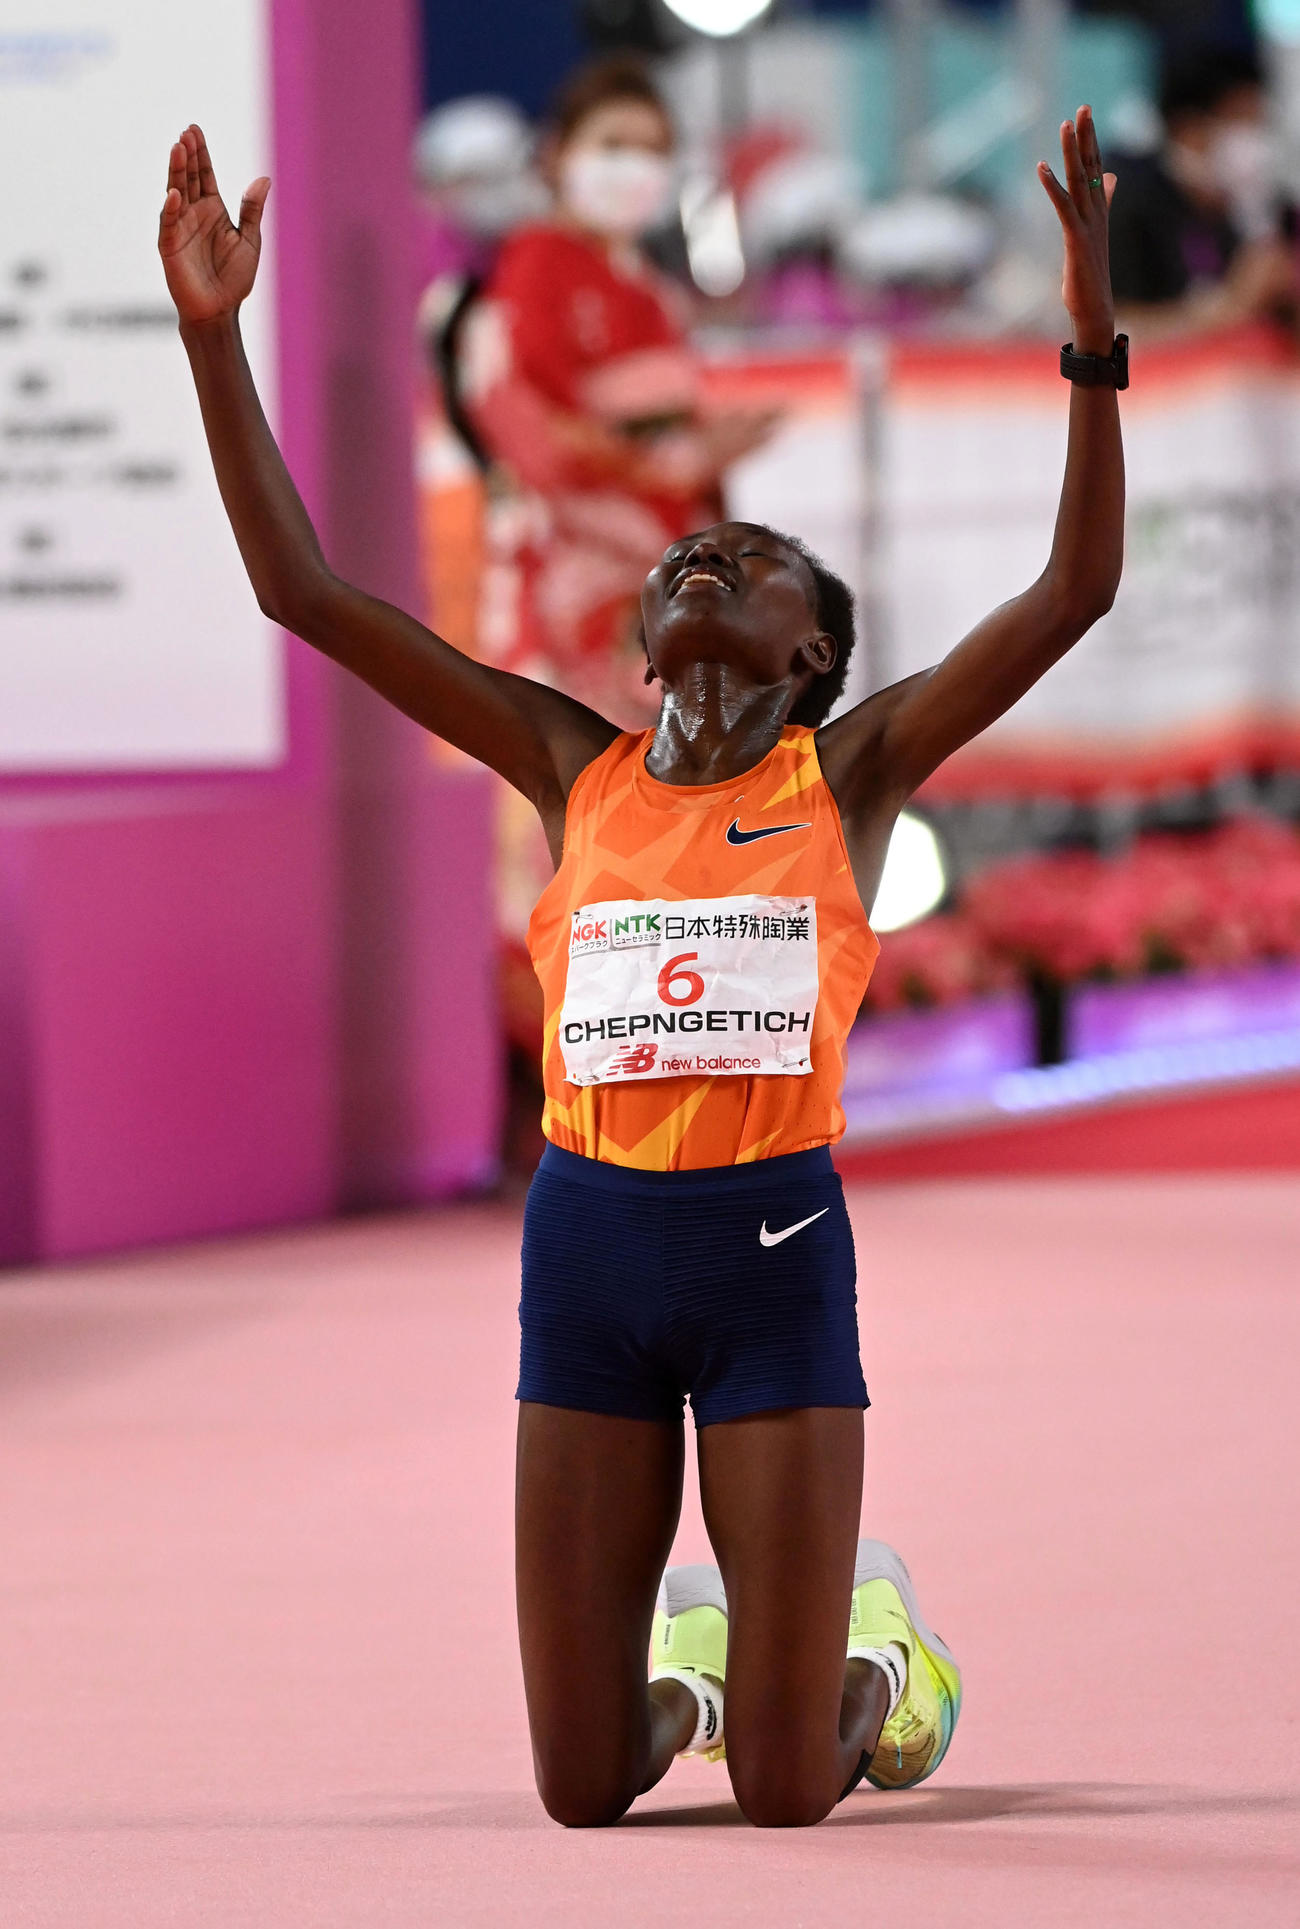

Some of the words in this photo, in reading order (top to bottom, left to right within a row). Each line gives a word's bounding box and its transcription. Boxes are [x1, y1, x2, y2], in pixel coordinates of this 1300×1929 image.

[572, 920, 607, 945] NGK
[615, 914, 661, 935] NTK
[665, 915, 810, 941] 日本特殊陶業
[657, 952, 705, 1007] 6
[564, 1010, 810, 1043] CHEPNGETICH
[661, 1058, 693, 1072] new
[696, 1055, 761, 1070] balance
